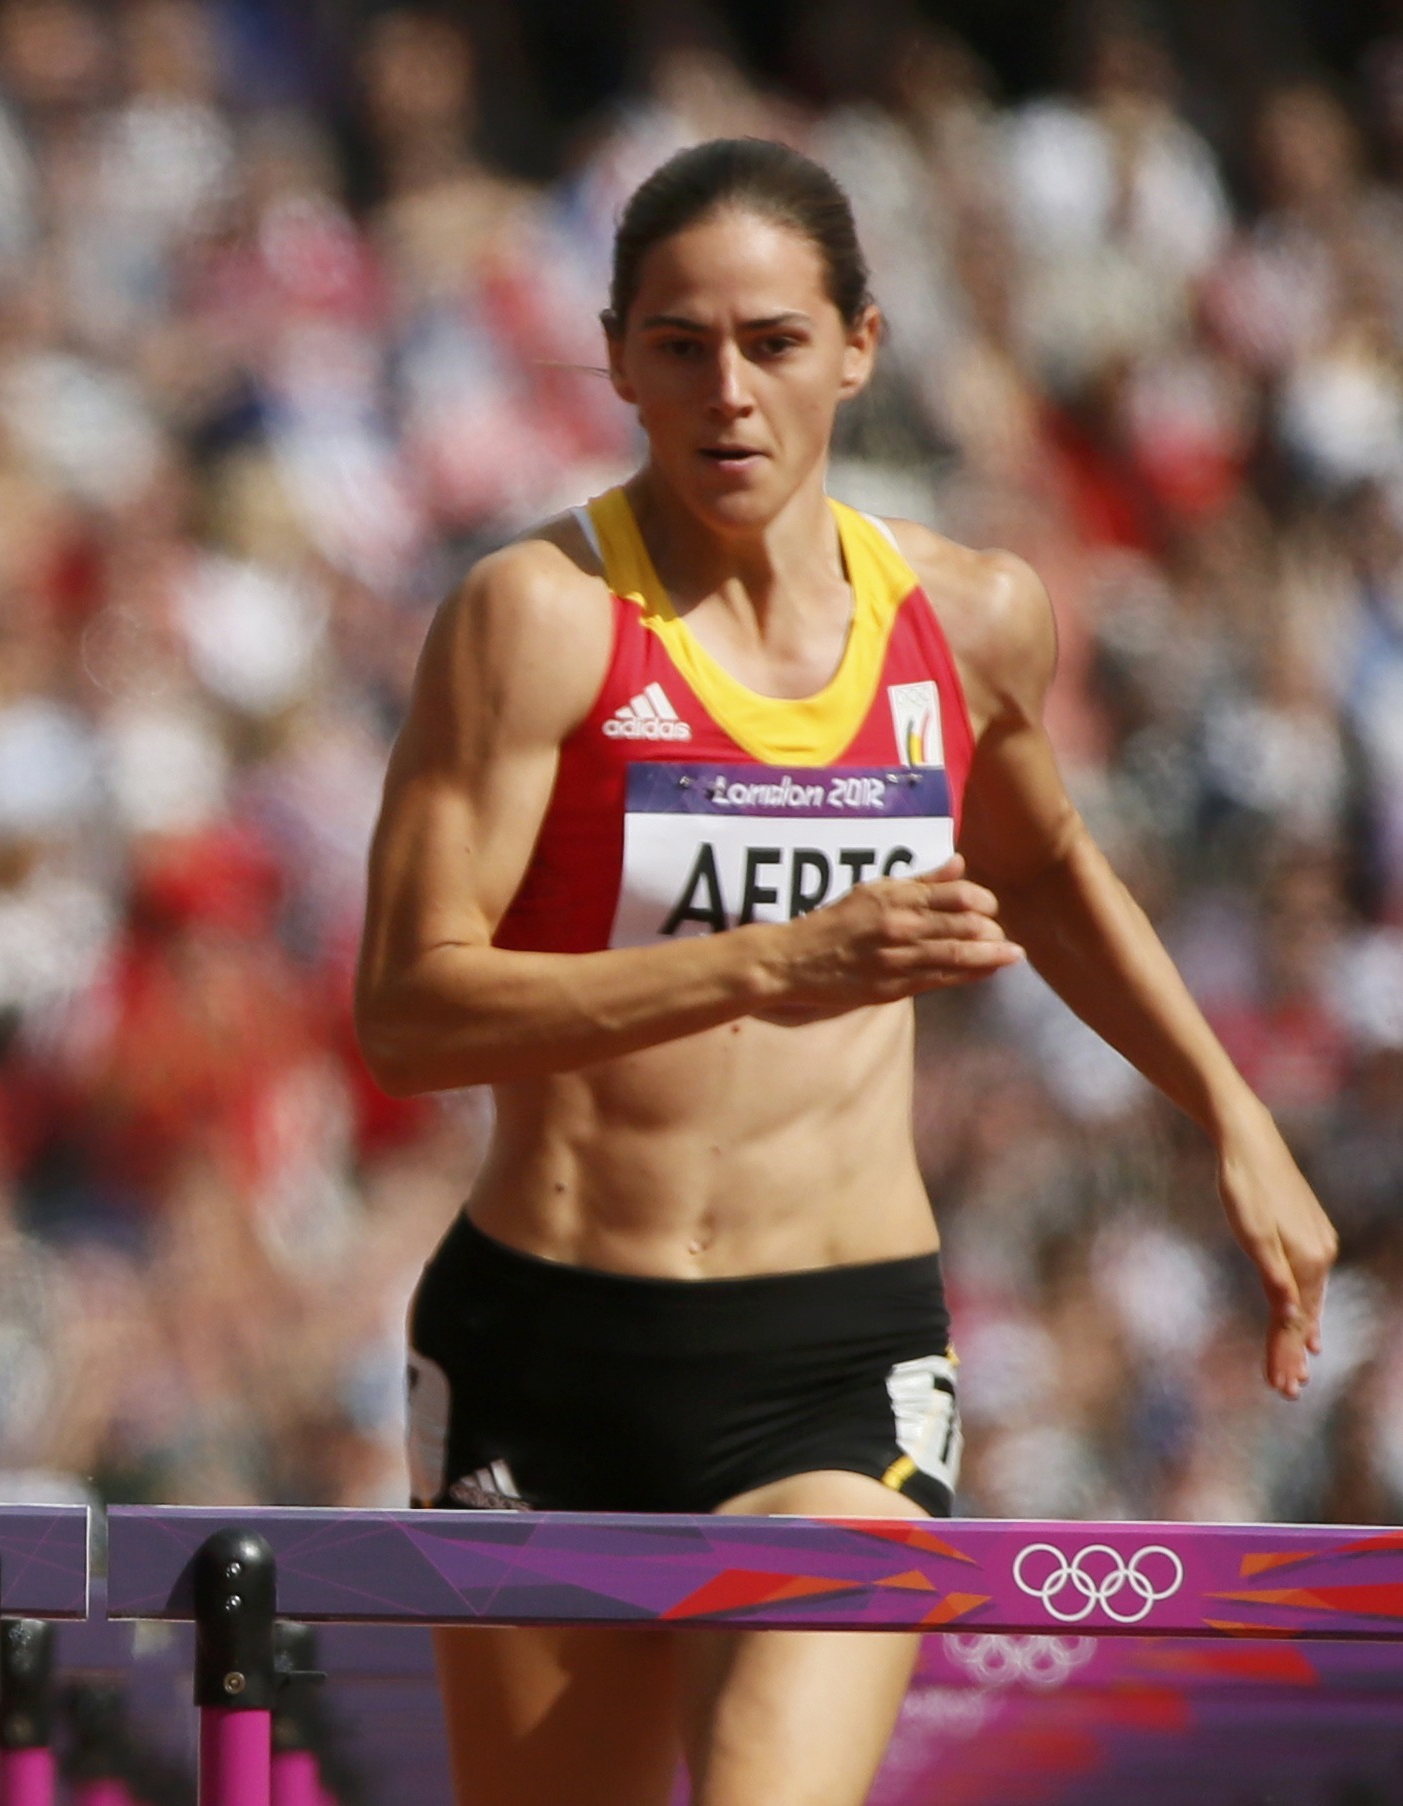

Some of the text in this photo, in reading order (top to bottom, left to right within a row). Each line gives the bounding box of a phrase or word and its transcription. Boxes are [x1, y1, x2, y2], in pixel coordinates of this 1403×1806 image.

[601, 717, 693, 742] adidas
[710, 774, 887, 810] London 2012
